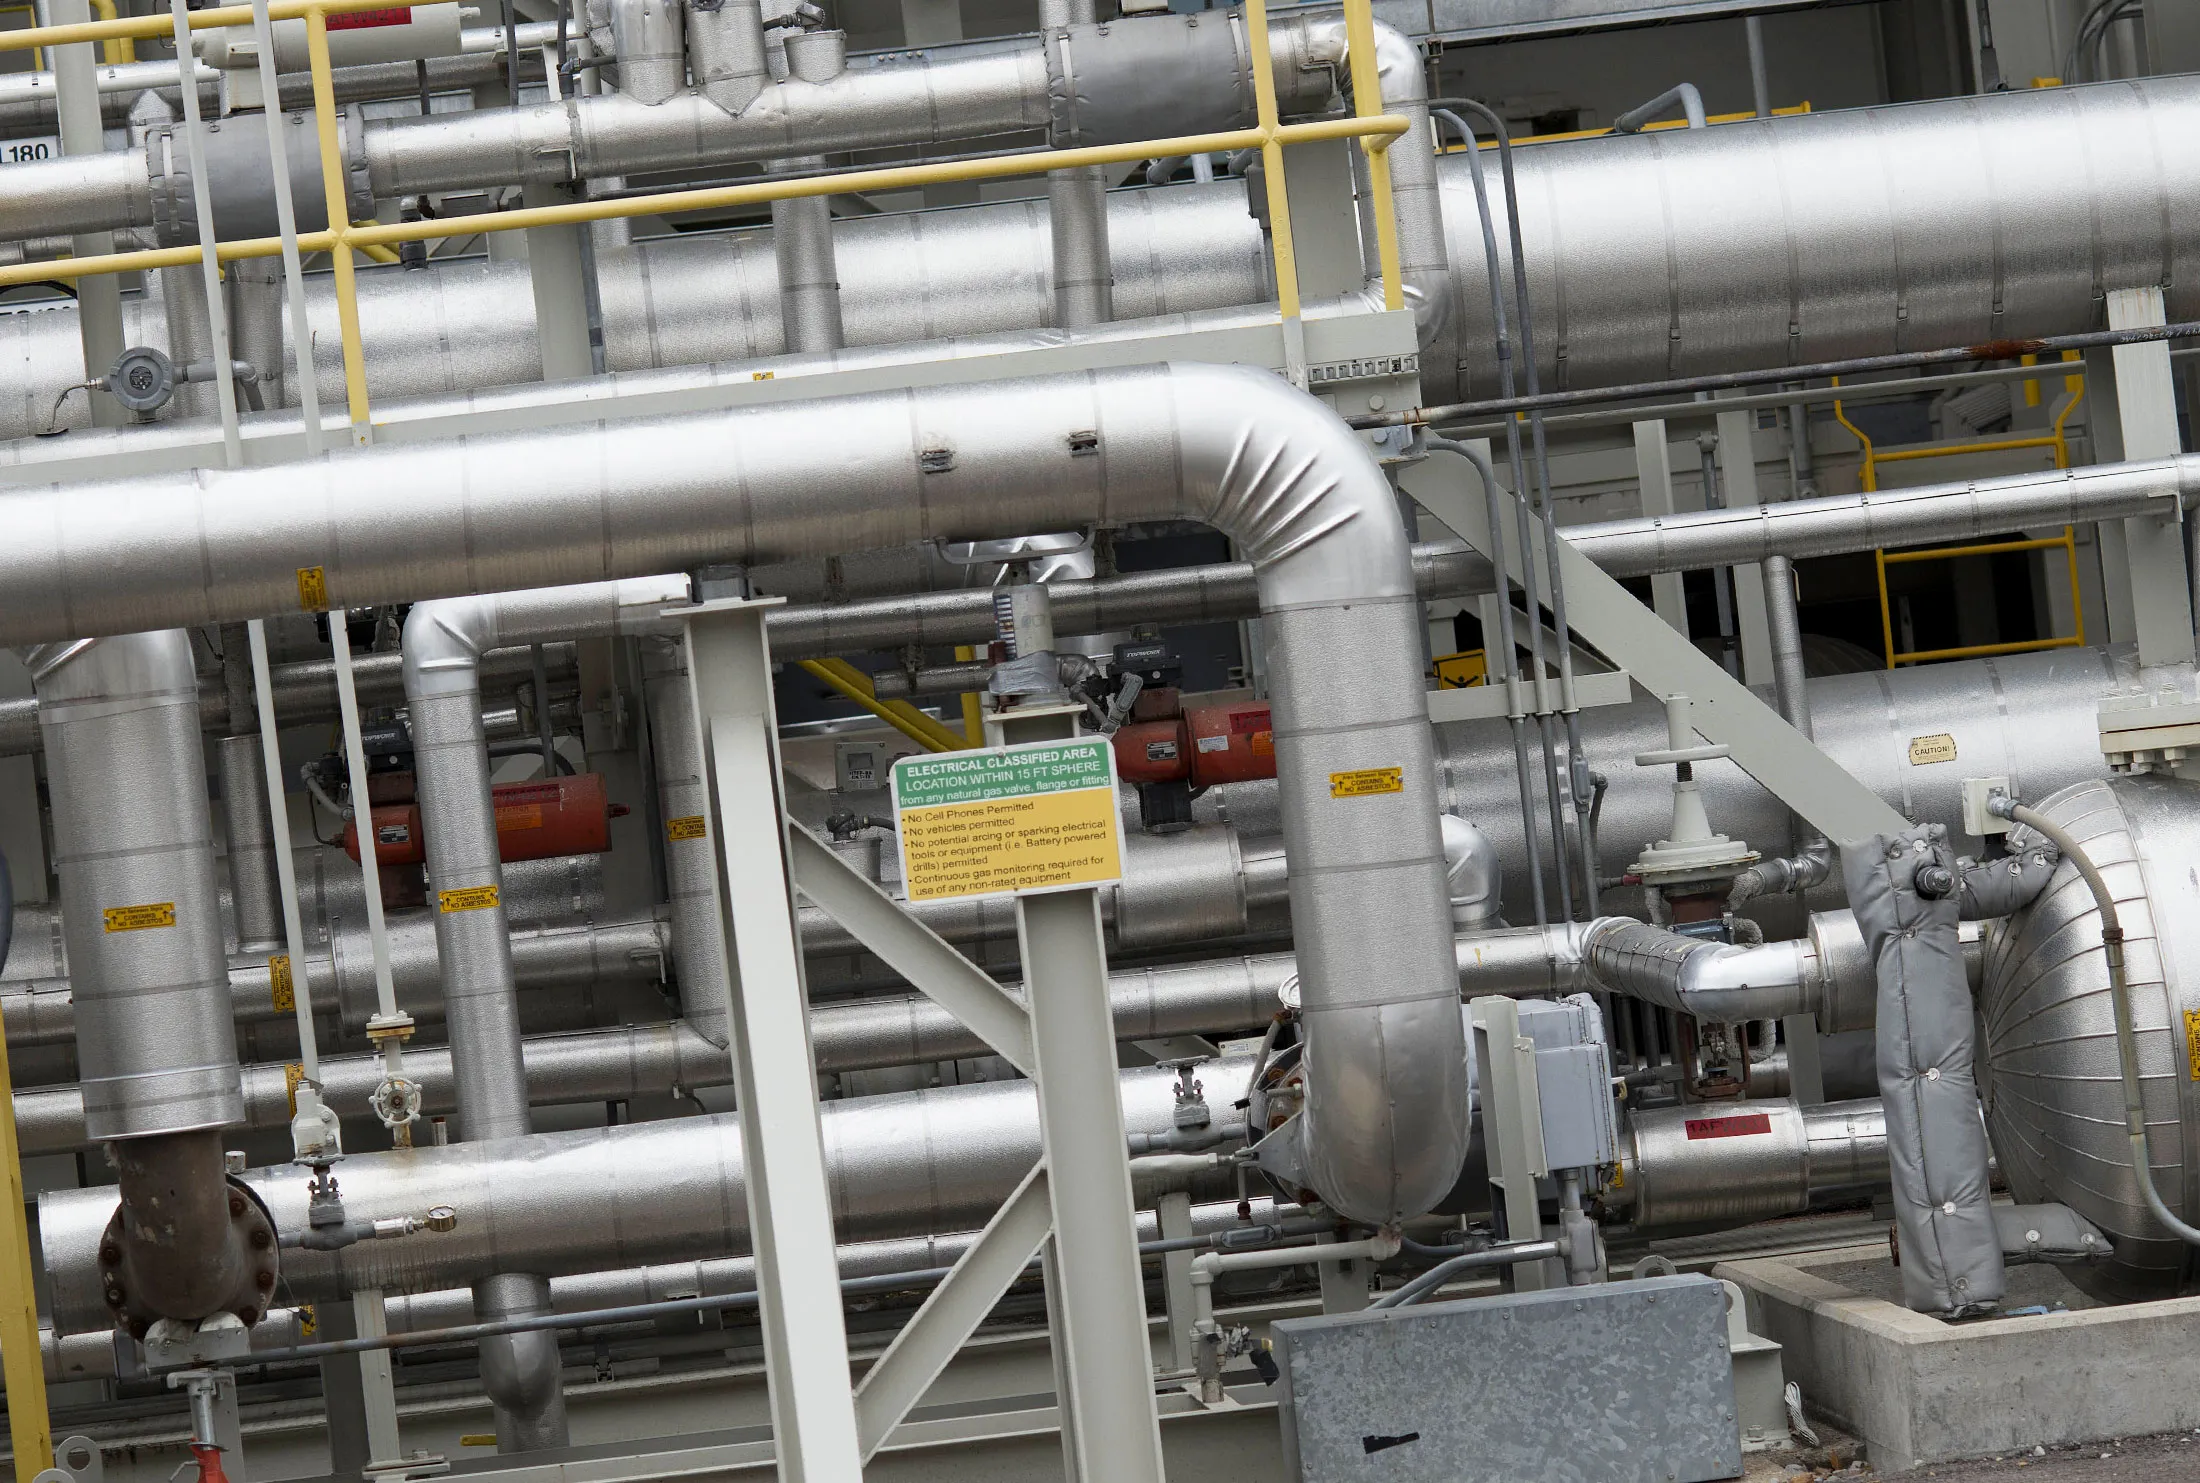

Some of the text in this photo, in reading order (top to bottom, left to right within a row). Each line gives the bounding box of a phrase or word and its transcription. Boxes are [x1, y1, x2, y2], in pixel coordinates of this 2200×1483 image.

[1915, 746, 1950, 755] CAUTION!
[907, 747, 1097, 778] ELECTRICAL CLASSIFIED AREA
[906, 761, 1101, 792] LOCATION WITHIN 15 FT SPHERE
[1351, 778, 1384, 786] CONTAINS
[1357, 783, 1391, 791] ASBESTOS
[900, 774, 1109, 806] from any natural gas valve, flange or fitting
[908, 802, 1034, 823] No Cell Phones Permitted
[910, 818, 1015, 836] No vehicles permitted
[910, 820, 1106, 850] No potential arcing or sparking electrical
[911, 848, 936, 860] tools
[938, 847, 948, 857] or
[950, 841, 1002, 856] equipment
[1026, 833, 1061, 848] Battery
[1063, 831, 1106, 846] powered
[913, 856, 988, 872] drills) permitted
[915, 855, 1104, 884] Continuous gas monitoring required for
[916, 870, 1071, 896] use of any non-rated equipment
[461, 899, 491, 907] ASBESTOS
